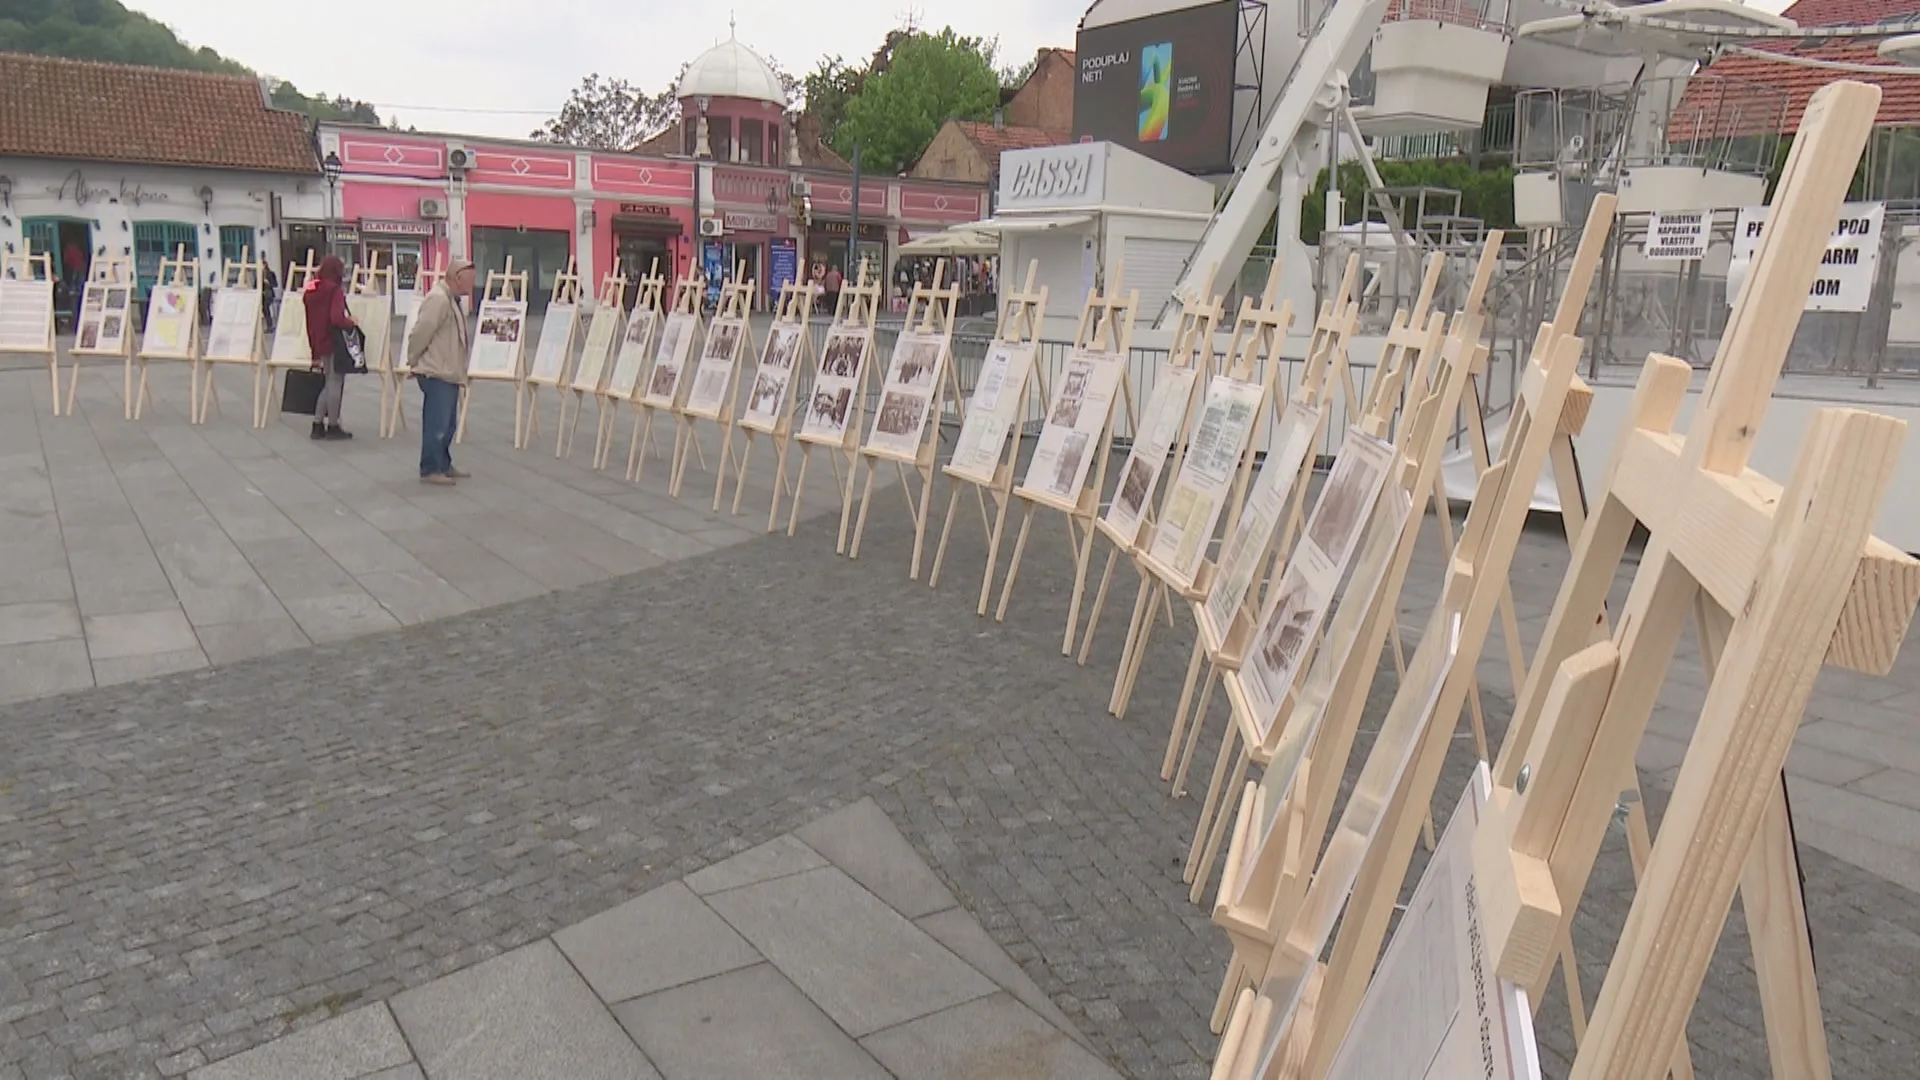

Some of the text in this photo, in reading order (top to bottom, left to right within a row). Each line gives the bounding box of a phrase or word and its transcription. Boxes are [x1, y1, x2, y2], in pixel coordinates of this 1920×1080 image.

[1082, 51, 1130, 70] PODUPLAJ
[1082, 69, 1103, 83] NET!
[1009, 153, 1094, 200] CASSA
[364, 222, 398, 232] ZLATAR
[1838, 219, 1871, 236] POD
